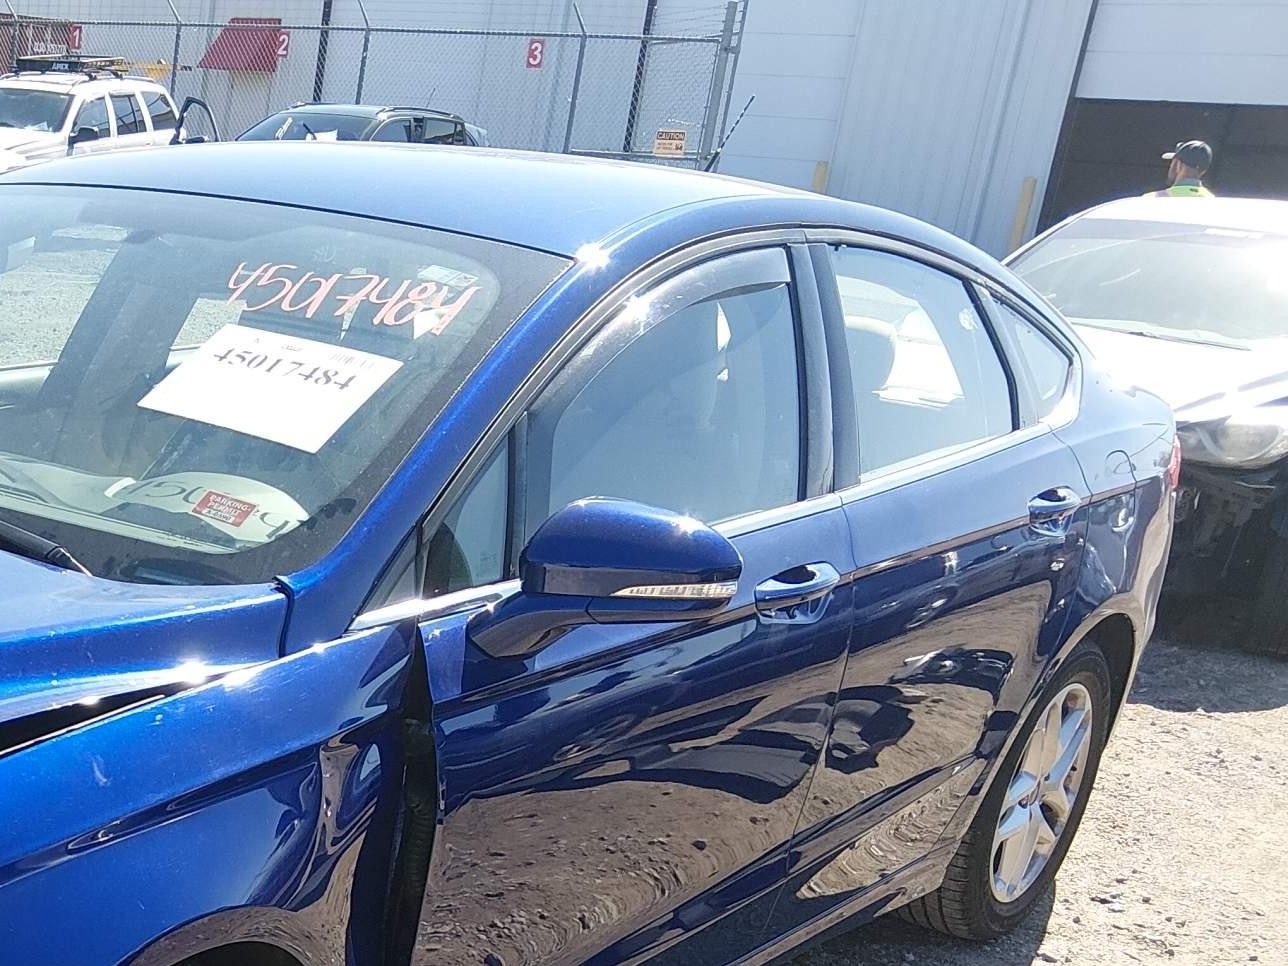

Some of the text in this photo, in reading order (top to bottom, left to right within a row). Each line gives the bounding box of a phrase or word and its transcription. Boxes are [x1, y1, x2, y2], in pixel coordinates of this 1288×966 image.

[73, 28, 80, 48] 1
[277, 34, 289, 55] 2
[528, 42, 542, 65] 3
[657, 132, 685, 140] CAUTION
[226, 261, 482, 337] 45017484
[213, 347, 357, 391] 45017484
[207, 501, 242, 516] PERMIT
[209, 494, 249, 511] PARKING
